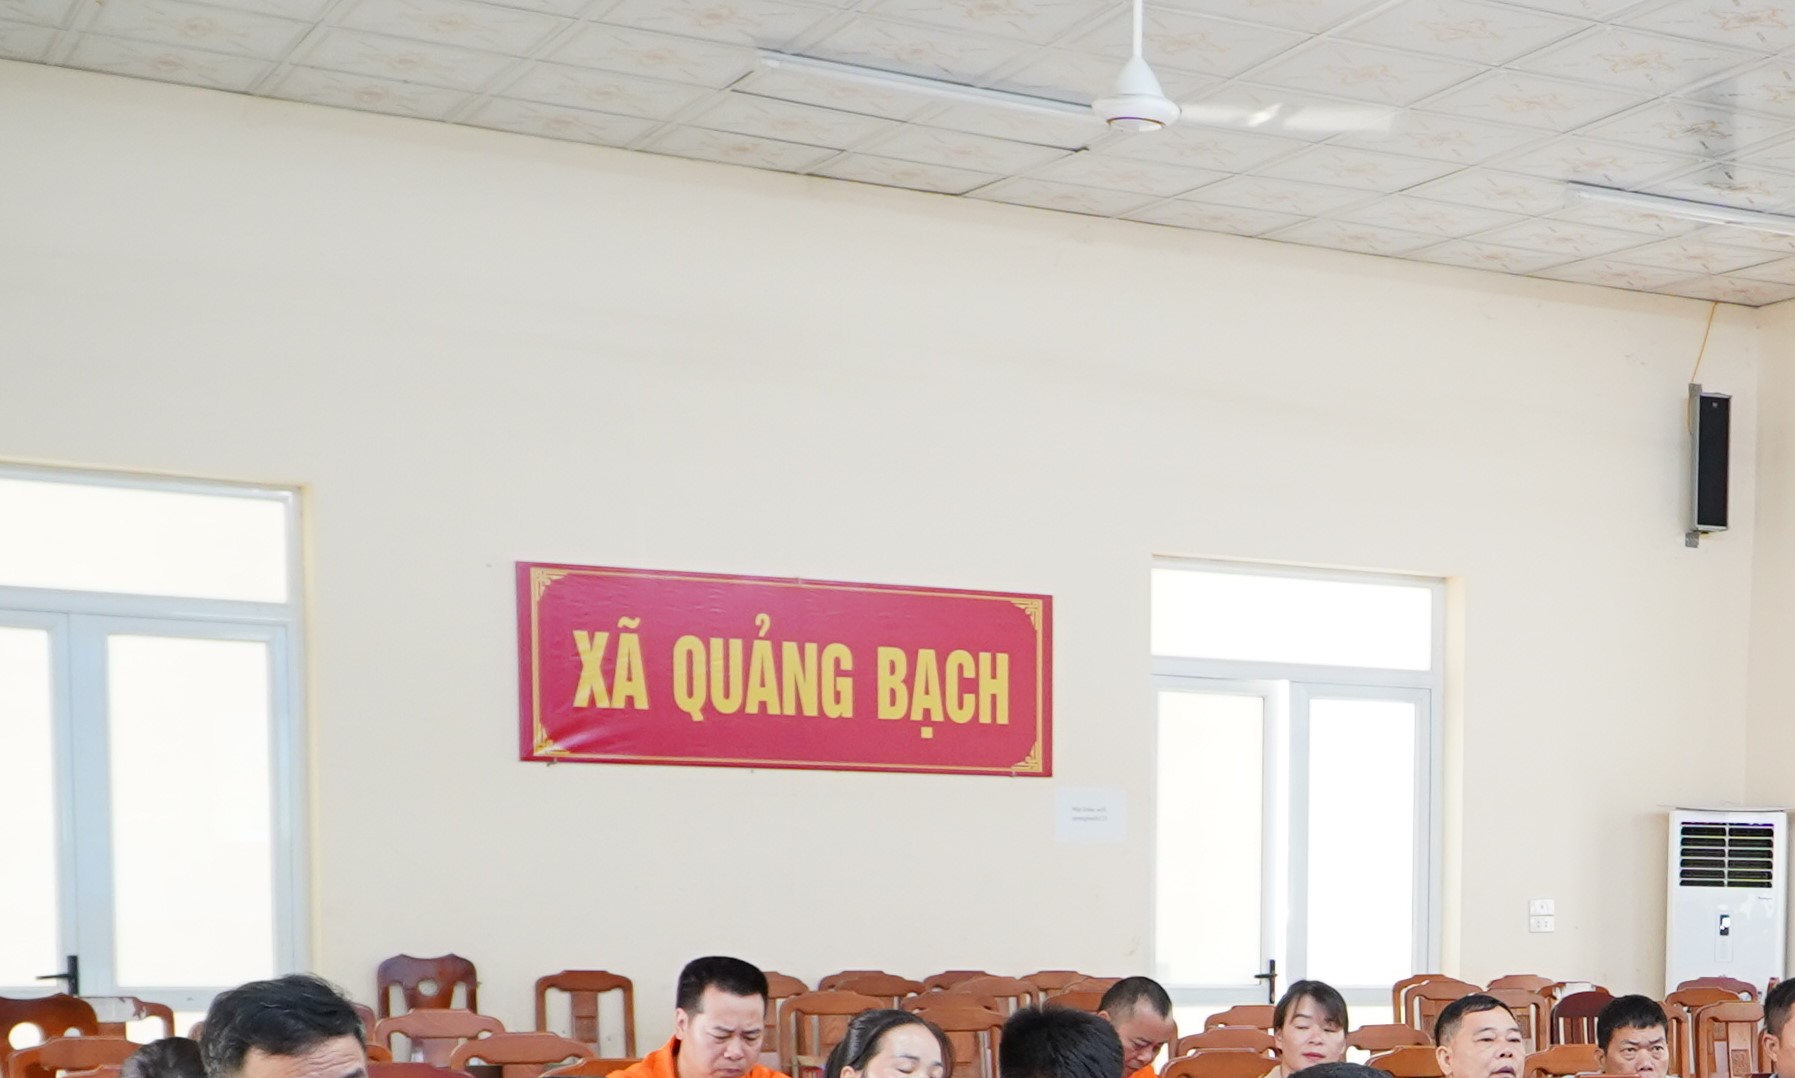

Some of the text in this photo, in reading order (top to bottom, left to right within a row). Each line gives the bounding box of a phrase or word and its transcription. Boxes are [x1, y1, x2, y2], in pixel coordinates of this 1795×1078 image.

[573, 613, 1009, 739] XÃ QUẢNG BẠCH
